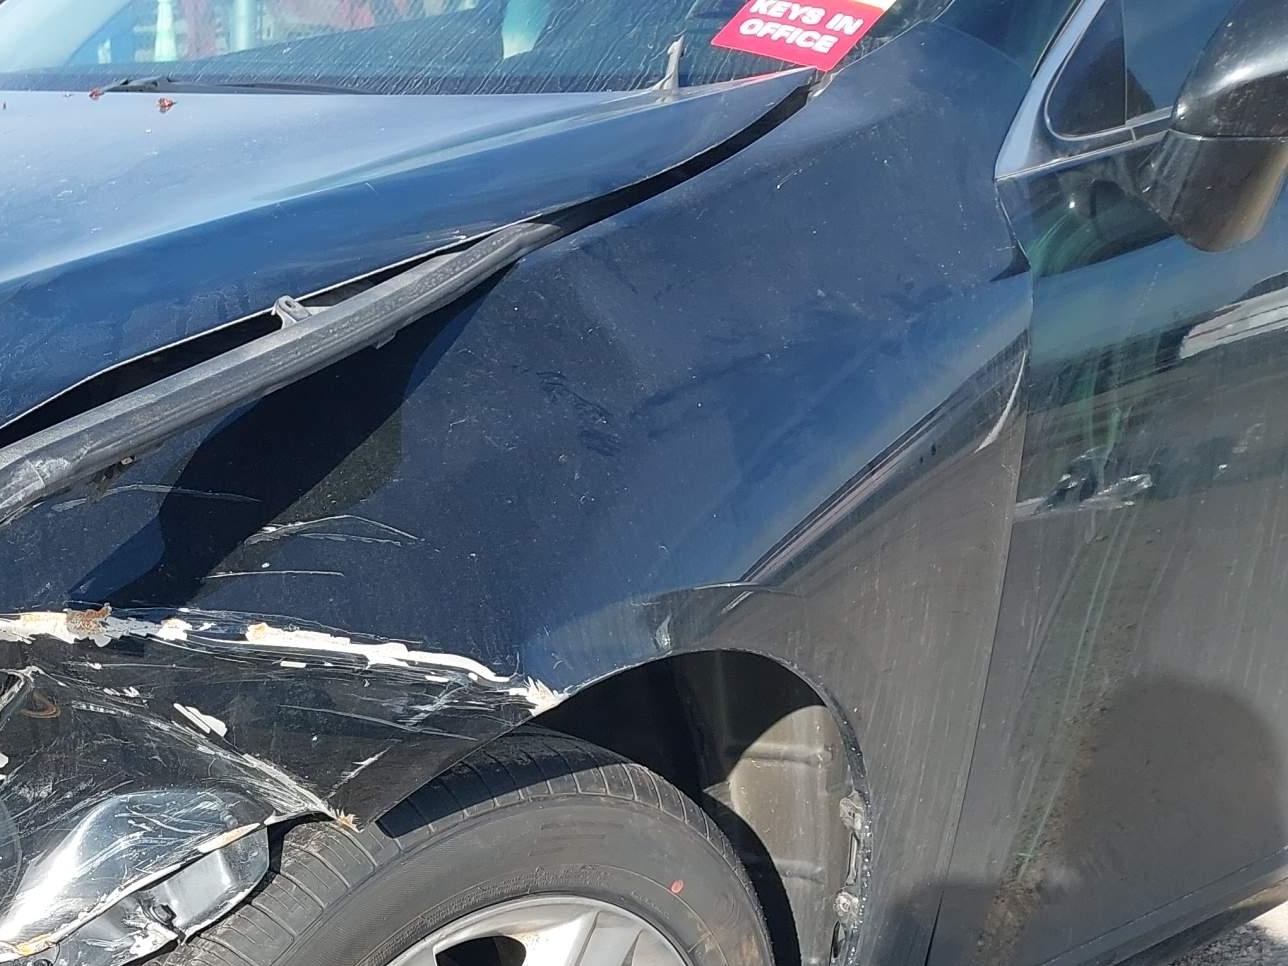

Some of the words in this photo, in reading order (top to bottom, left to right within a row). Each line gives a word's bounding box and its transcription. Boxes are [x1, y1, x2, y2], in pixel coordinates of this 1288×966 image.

[739, 18, 839, 54] OFFICE
[749, 0, 826, 25] KEYS
[825, 13, 864, 36] IN
